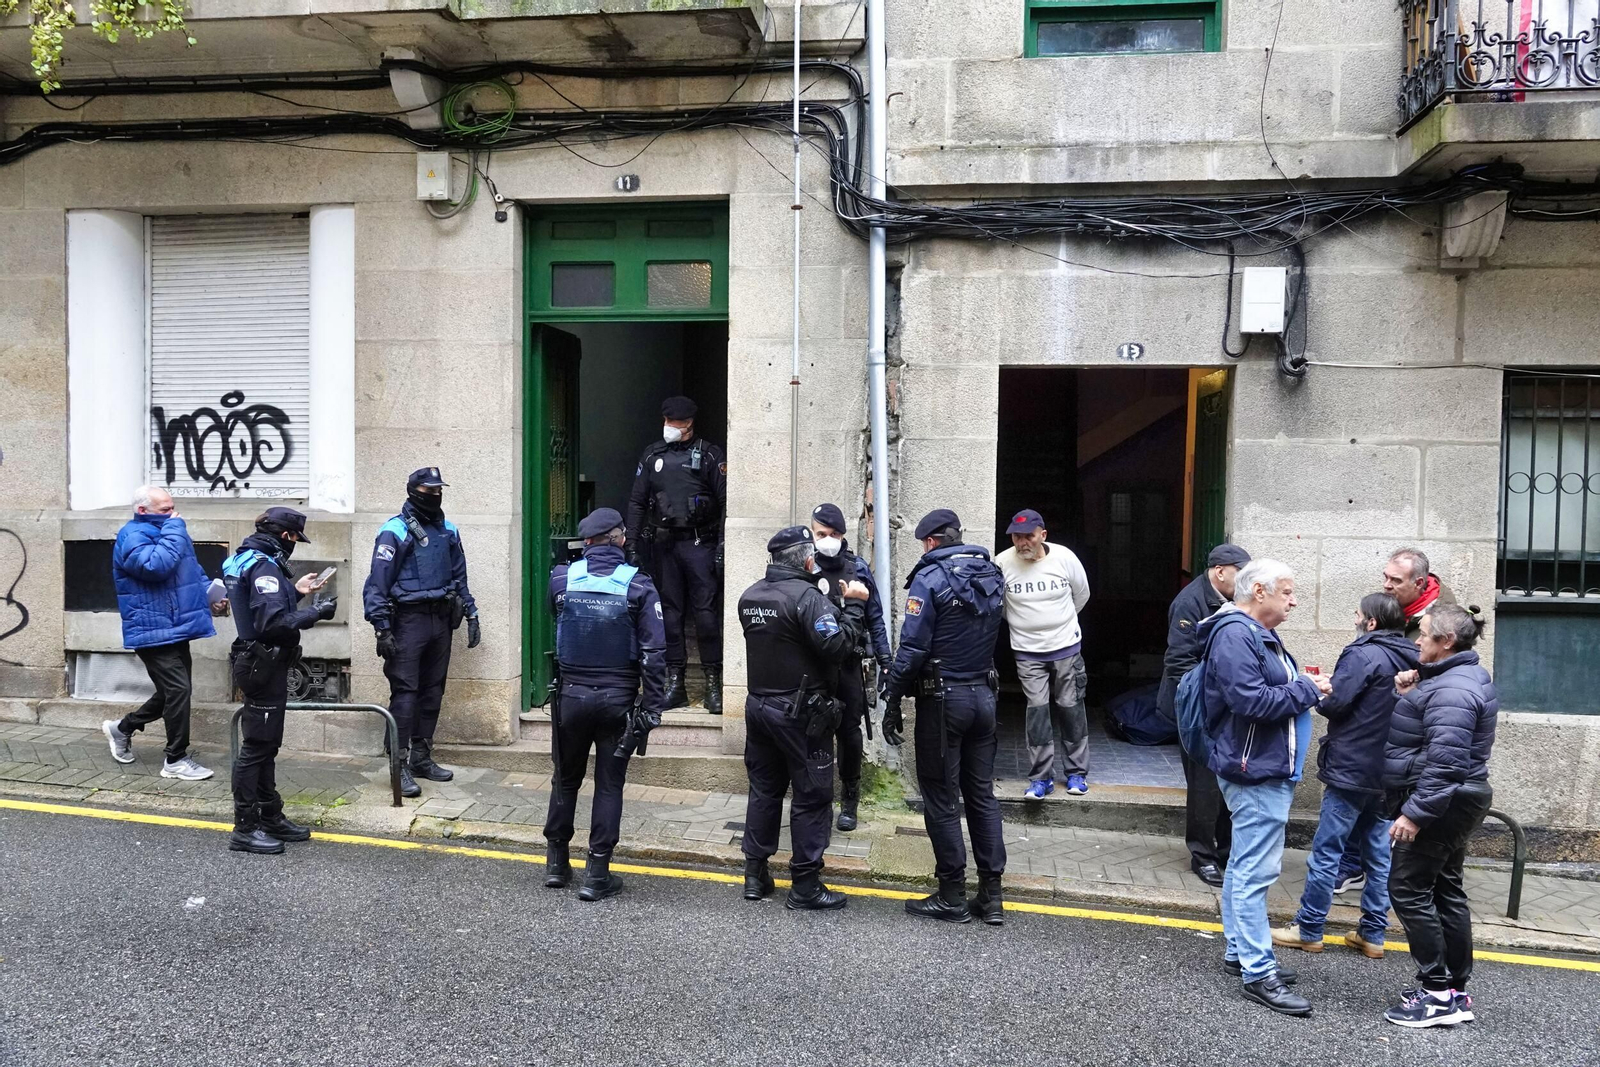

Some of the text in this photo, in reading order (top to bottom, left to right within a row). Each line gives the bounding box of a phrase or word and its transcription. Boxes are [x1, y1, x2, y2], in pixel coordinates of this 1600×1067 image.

[616, 175, 631, 190] 11
[1120, 343, 1140, 361] 13
[762, 608, 778, 618] LOCAL
